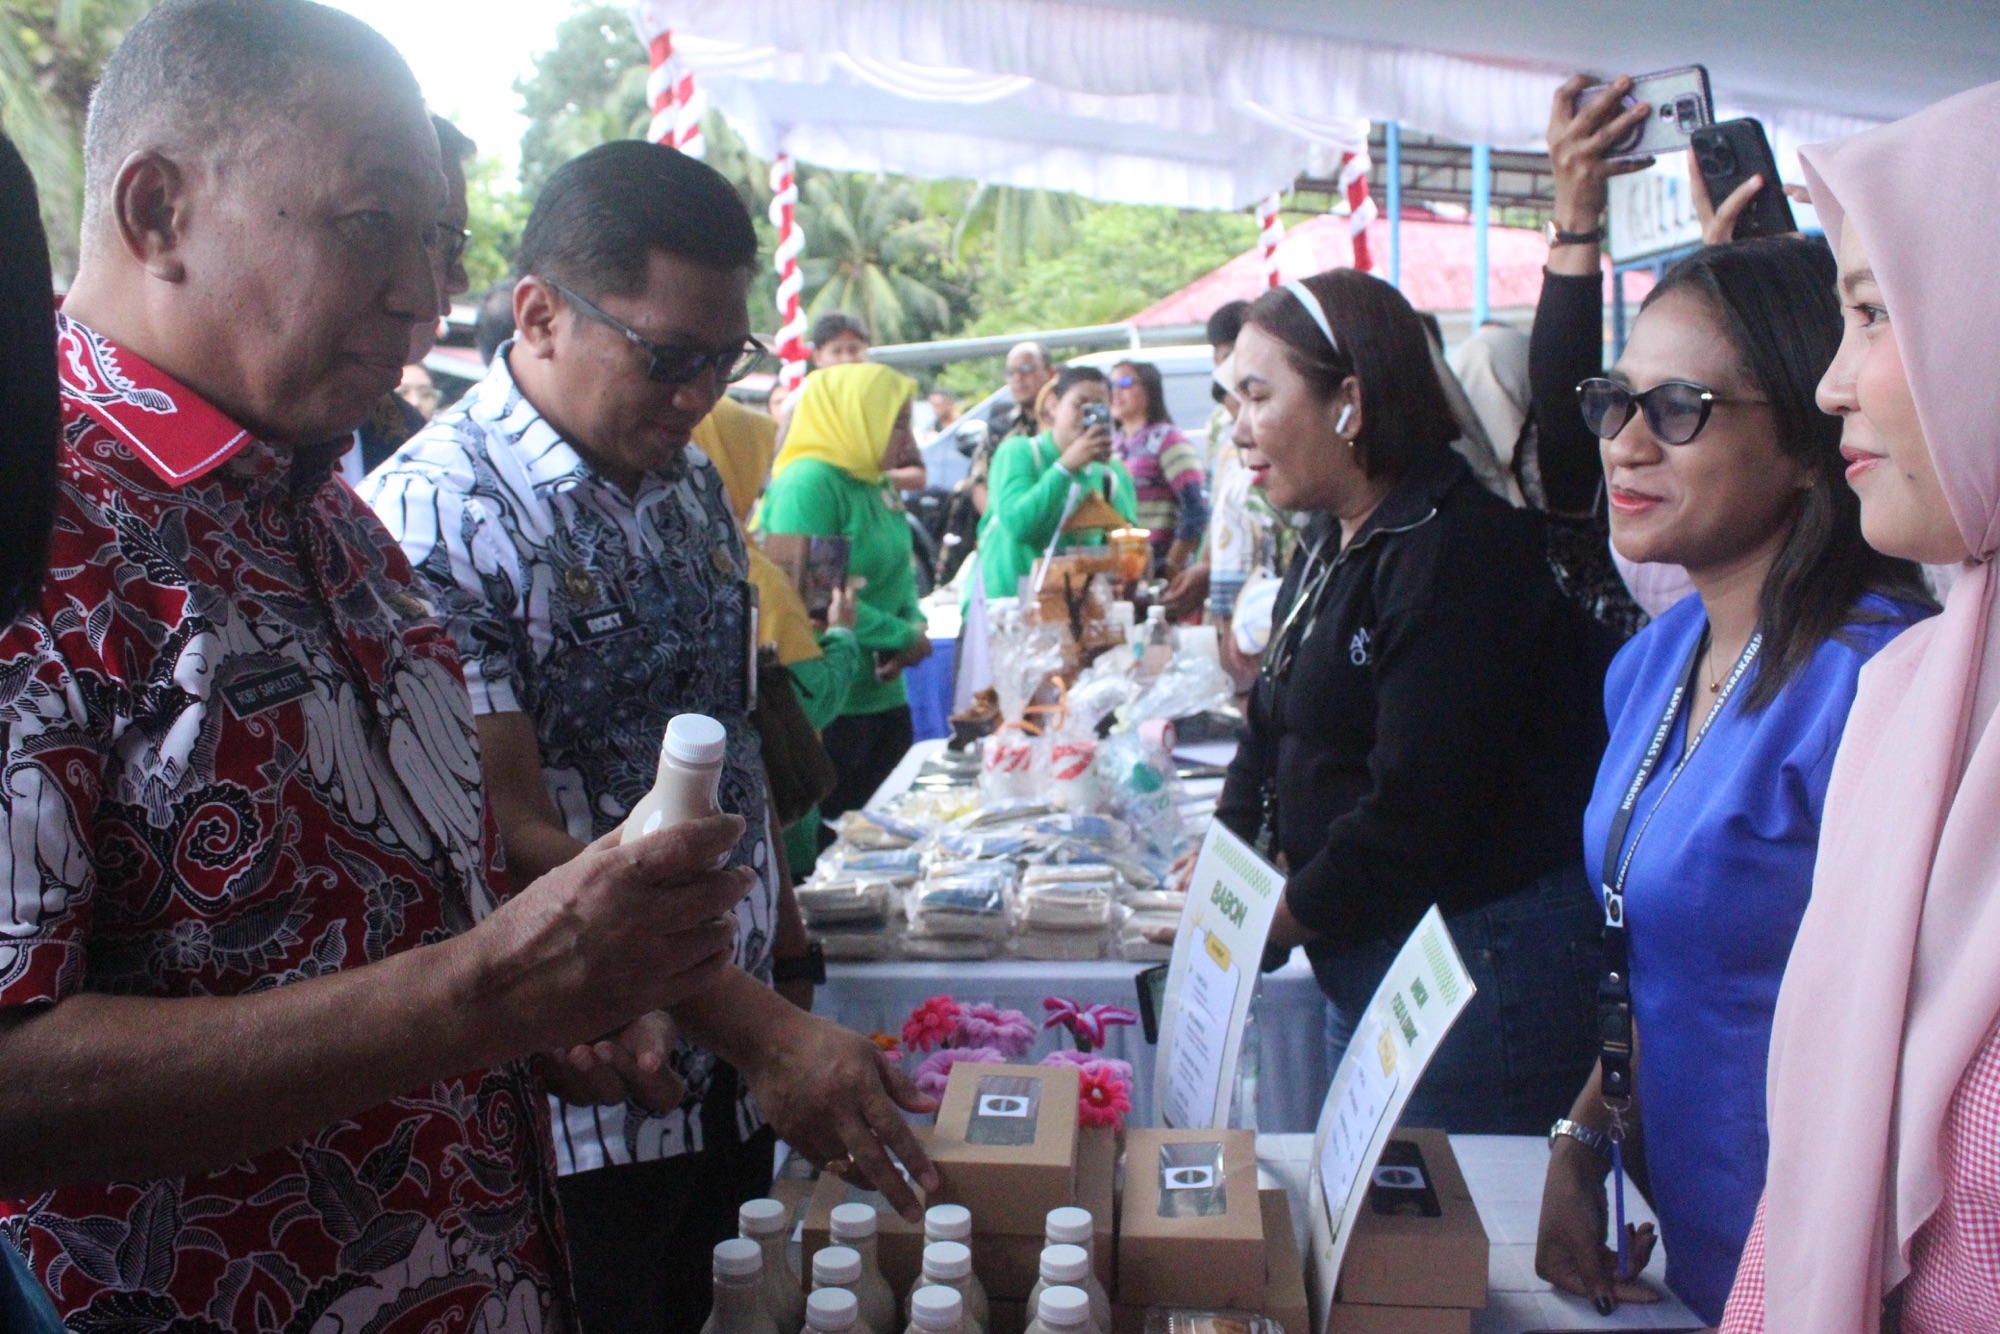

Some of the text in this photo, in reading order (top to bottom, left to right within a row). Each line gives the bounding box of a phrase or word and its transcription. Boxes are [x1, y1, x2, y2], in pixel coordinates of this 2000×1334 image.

[1664, 686, 1684, 721] BAPAS
[1648, 724, 1668, 757] KELAS
[1621, 770, 1646, 811] AMBON
[1210, 879, 1248, 929] BABON
